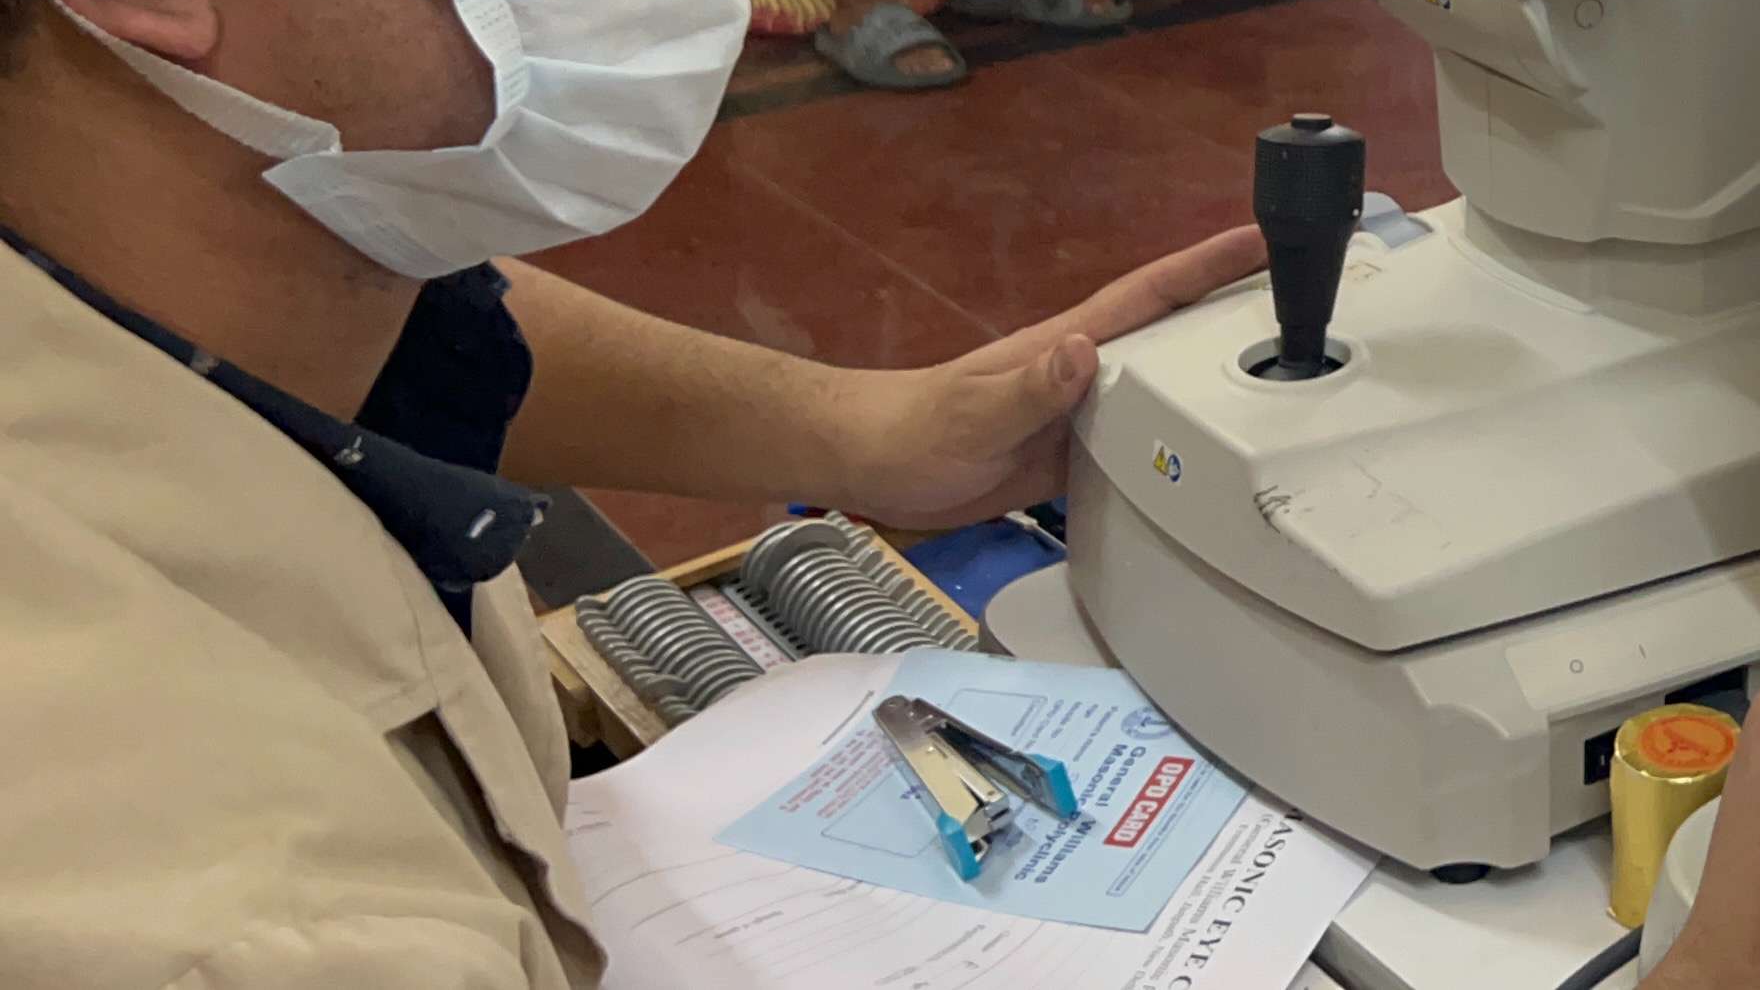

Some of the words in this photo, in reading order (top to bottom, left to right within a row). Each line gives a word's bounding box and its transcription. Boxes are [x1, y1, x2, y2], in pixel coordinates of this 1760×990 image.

[1095, 745, 1147, 807] General
[1144, 762, 1184, 799] OPD
[1113, 800, 1159, 843] CARD
[1033, 818, 1097, 884] Williams
[1184, 918, 1232, 970] EYE
